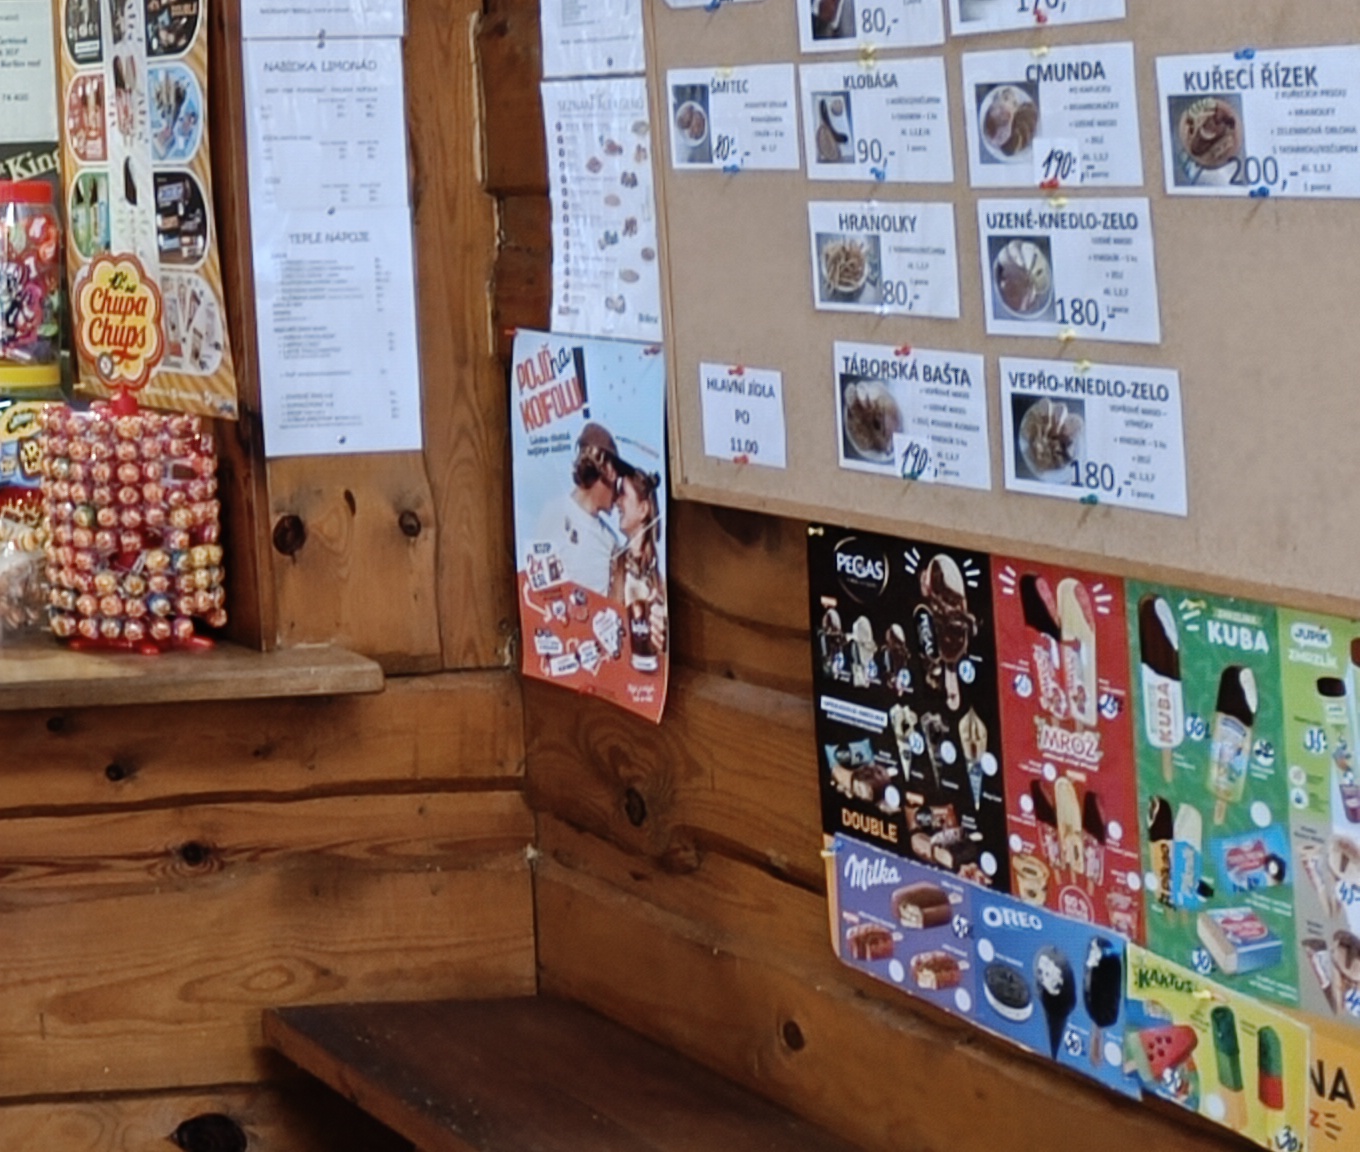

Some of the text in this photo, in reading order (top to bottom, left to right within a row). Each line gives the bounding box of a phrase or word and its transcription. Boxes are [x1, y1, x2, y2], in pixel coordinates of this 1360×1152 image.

[1026, 61, 1105, 83] CMUNDA
[1184, 62, 1318, 91] KUŘECÍ ŘÍZEK
[838, 213, 917, 232] HRANOLKY
[89, 285, 148, 323] Chupa
[88, 317, 147, 350] Chups
[842, 356, 971, 387] TÁBORSKÁ BAŠTA
[1207, 620, 1269, 654] KUBA
[841, 807, 898, 843] DOUBLE
[844, 852, 901, 888] Milka
[982, 904, 1043, 931] OREO
